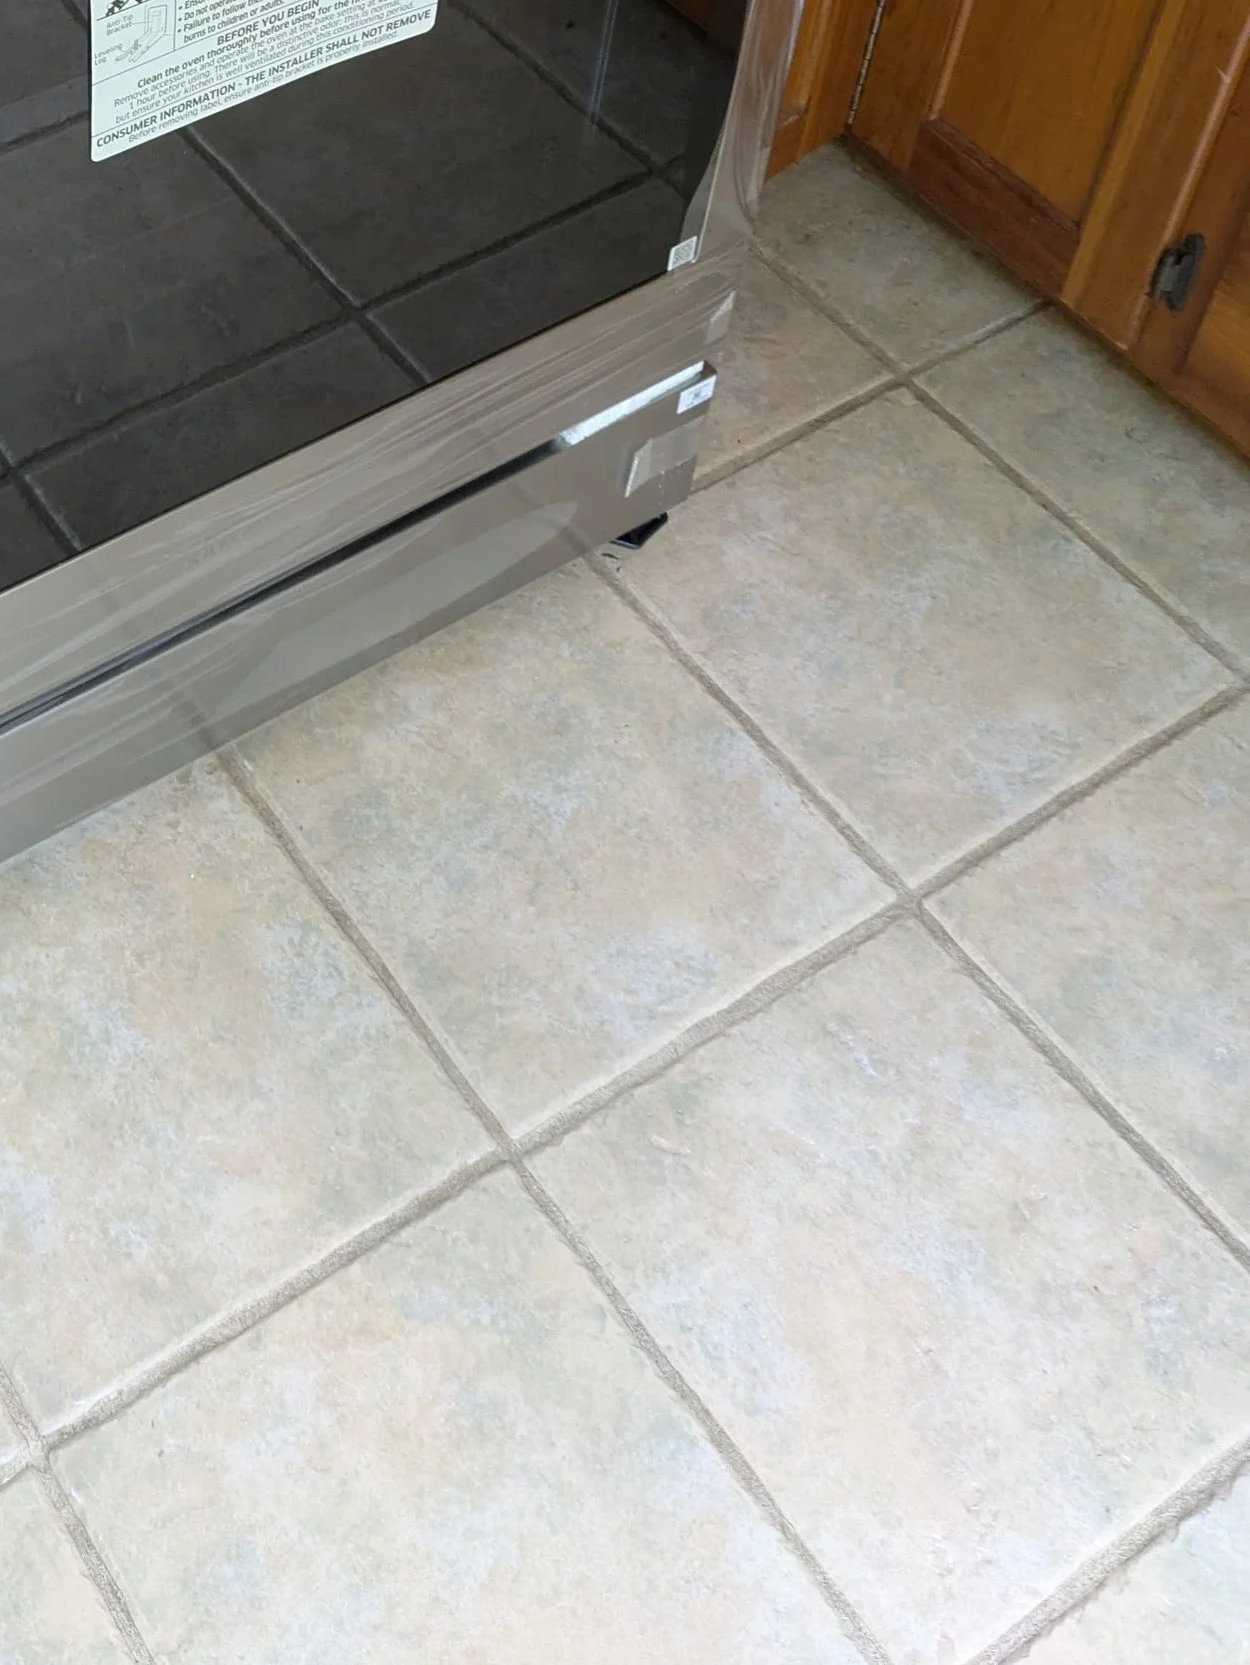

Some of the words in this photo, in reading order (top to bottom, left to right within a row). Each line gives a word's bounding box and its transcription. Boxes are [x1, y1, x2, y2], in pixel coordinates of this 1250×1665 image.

[114, 88, 149, 107] Remove
[150, 68, 196, 91] accessories
[199, 58, 215, 71] and
[216, 46, 249, 64] operate
[251, 40, 265, 50] the
[266, 32, 287, 44] oven
[289, 26, 297, 35] at
[299, 22, 312, 32] the
[314, 14, 334, 26] bake
[336, 3, 365, 18] setting
[137, 73, 162, 88] Clean
[165, 66, 180, 77] the
[181, 55, 204, 70] oven
[207, 34, 257, 59] thoroughly
[259, 21, 289, 38] before
[291, 11, 315, 26] using
[317, 6, 330, 16] for
[333, 0, 349, 10] the
[183, 11, 194, 20] Do
[195, 4, 207, 16] not
[183, 16, 210, 32] Failure
[222, 2, 246, 16] follow
[183, 29, 206, 43] burns
[217, 12, 248, 30] children
[216, 21, 259, 45] BEFORE
[261, 11, 284, 27] YOU
[96, 115, 157, 148] CONSUMER
[160, 82, 235, 121] INFORMATION
[244, 70, 265, 86] THE
[268, 46, 323, 76] INSTALLER
[325, 33, 358, 53] SHALL
[361, 24, 384, 40] NOT
[386, 8, 431, 31] REMOVE
[115, 112, 130, 124] but
[131, 100, 160, 117] ensure
[162, 91, 181, 106] your
[183, 78, 213, 95] kitchen
[225, 65, 242, 77] well
[245, 48, 286, 70] ventilated
[287, 38, 314, 53] during
[316, 32, 331, 42] this
[332, 13, 384, 36] conditioning
[128, 126, 156, 143] Before
[158, 109, 198, 130] removing
[223, 87, 252, 102] ensure
[253, 74, 284, 91] anti-tip
[285, 59, 315, 78] bracket
[325, 44, 360, 63] properly
[136, 93, 157, 107] hour
[158, 81, 186, 97] before
[215, 60, 238, 73] There
[240, 51, 255, 63] will
[257, 48, 268, 57] be
[276, 29, 318, 49] distinctive
[344, 13, 359, 24] this
